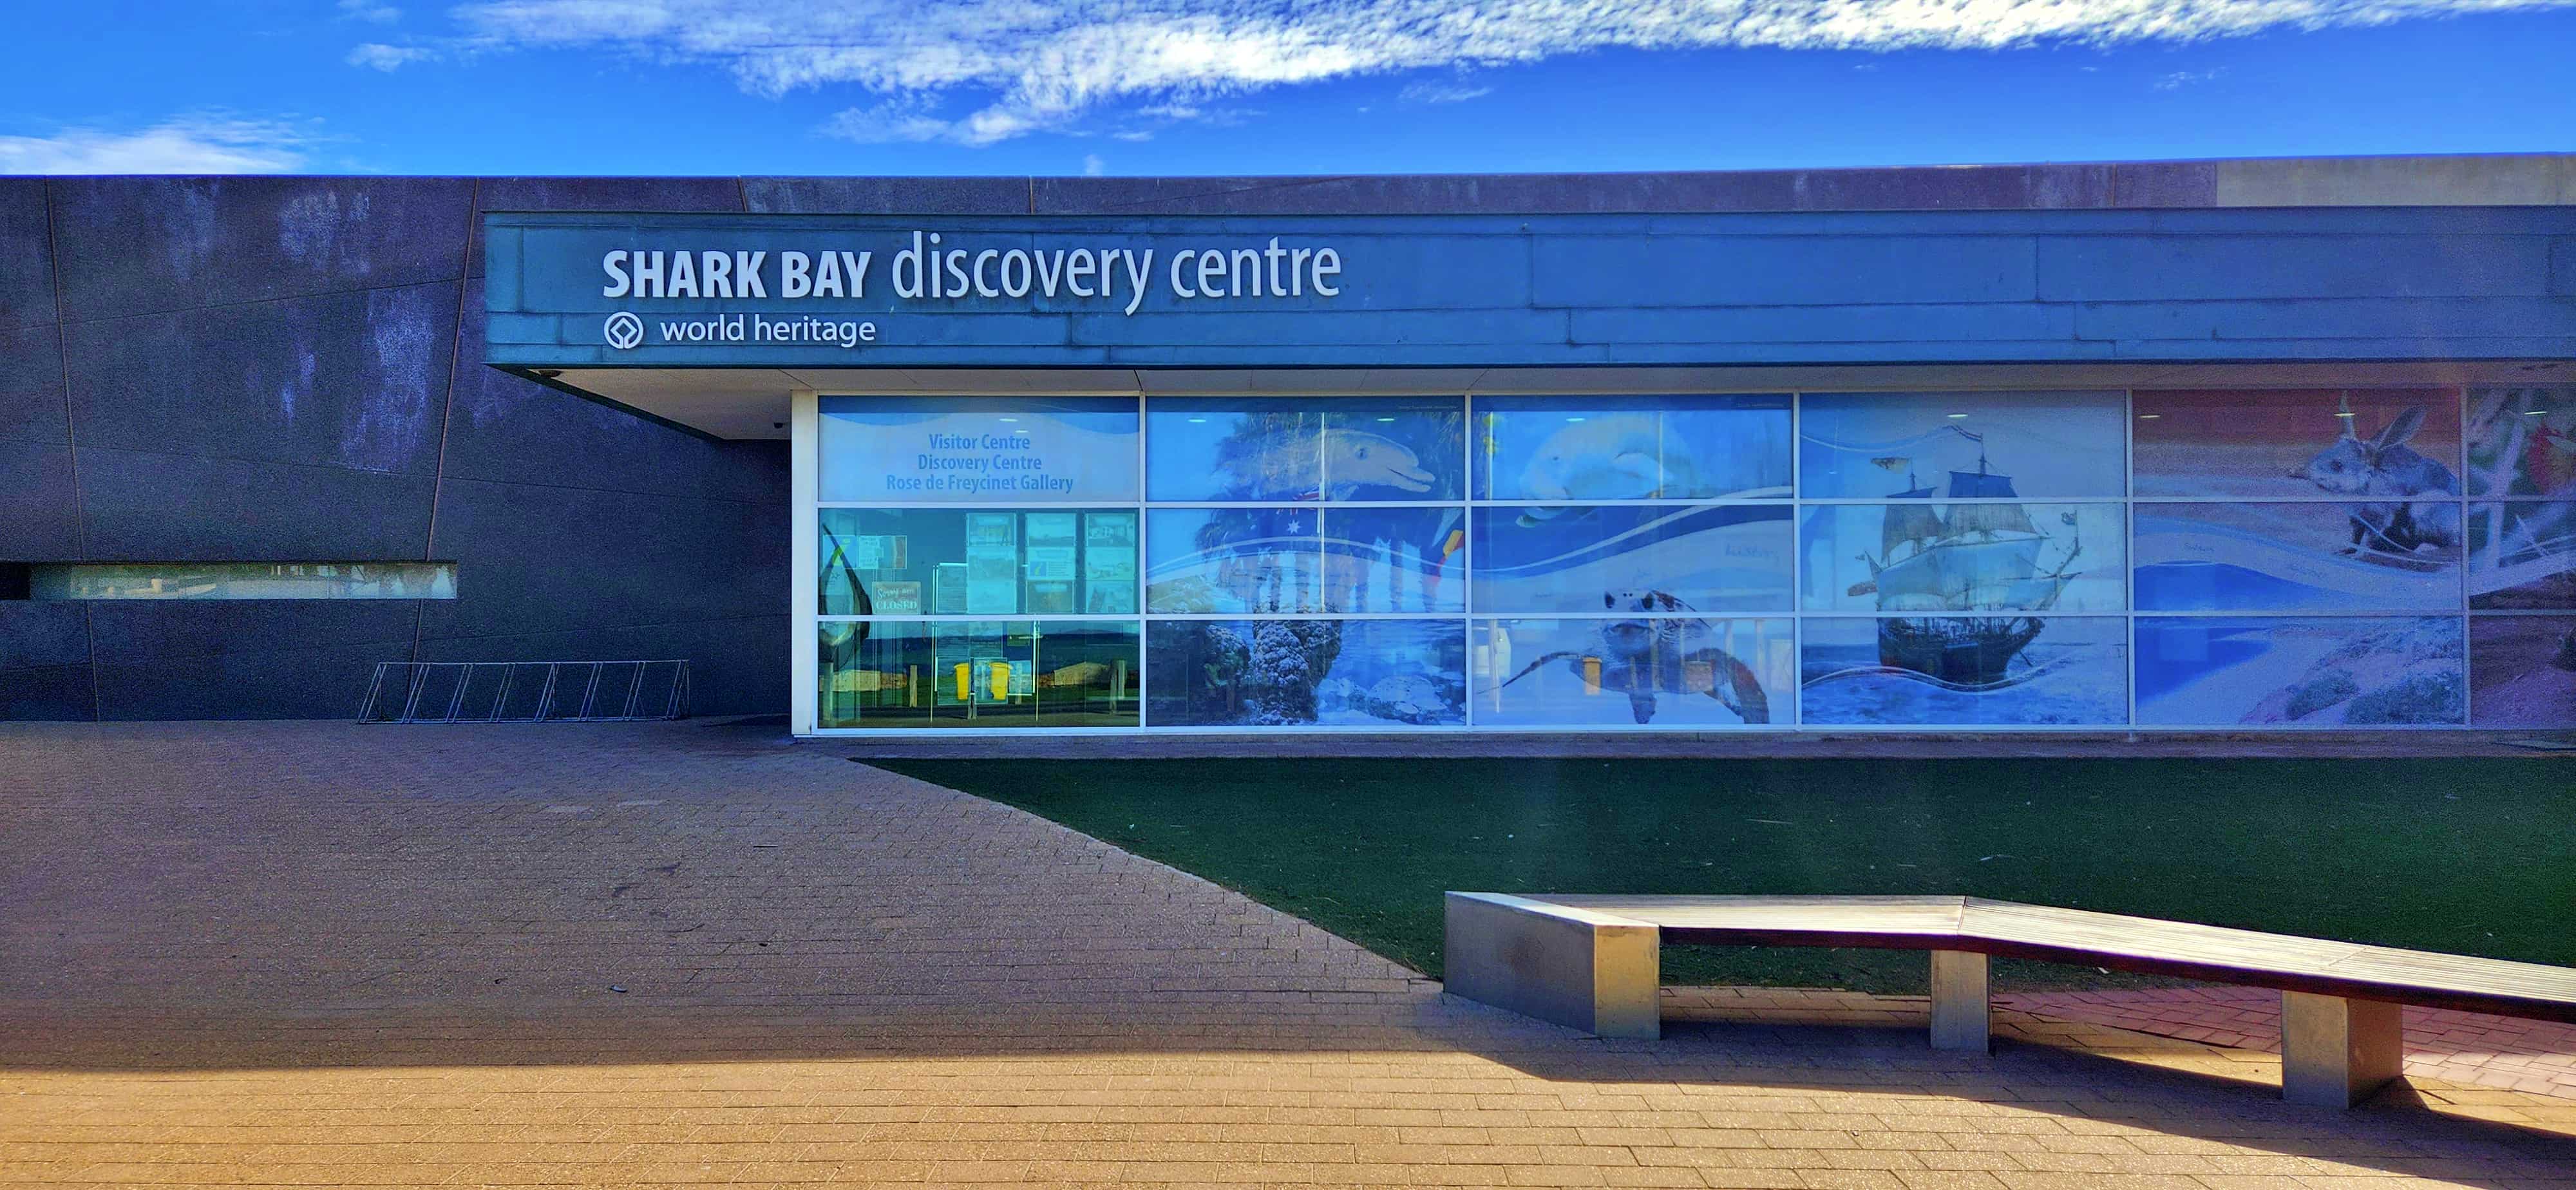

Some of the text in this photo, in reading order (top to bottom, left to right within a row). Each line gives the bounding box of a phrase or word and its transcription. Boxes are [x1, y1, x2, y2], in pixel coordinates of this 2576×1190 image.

[603, 231, 1341, 316] SHARK BAY discovery centre
[660, 314, 876, 348] world heritage
[929, 434, 1030, 449] Visitor Centre
[918, 454, 1042, 473] Discovery Centre
[887, 475, 1074, 494] Rose de Freycinet Gallery
[875, 601, 918, 609] CLOSED
